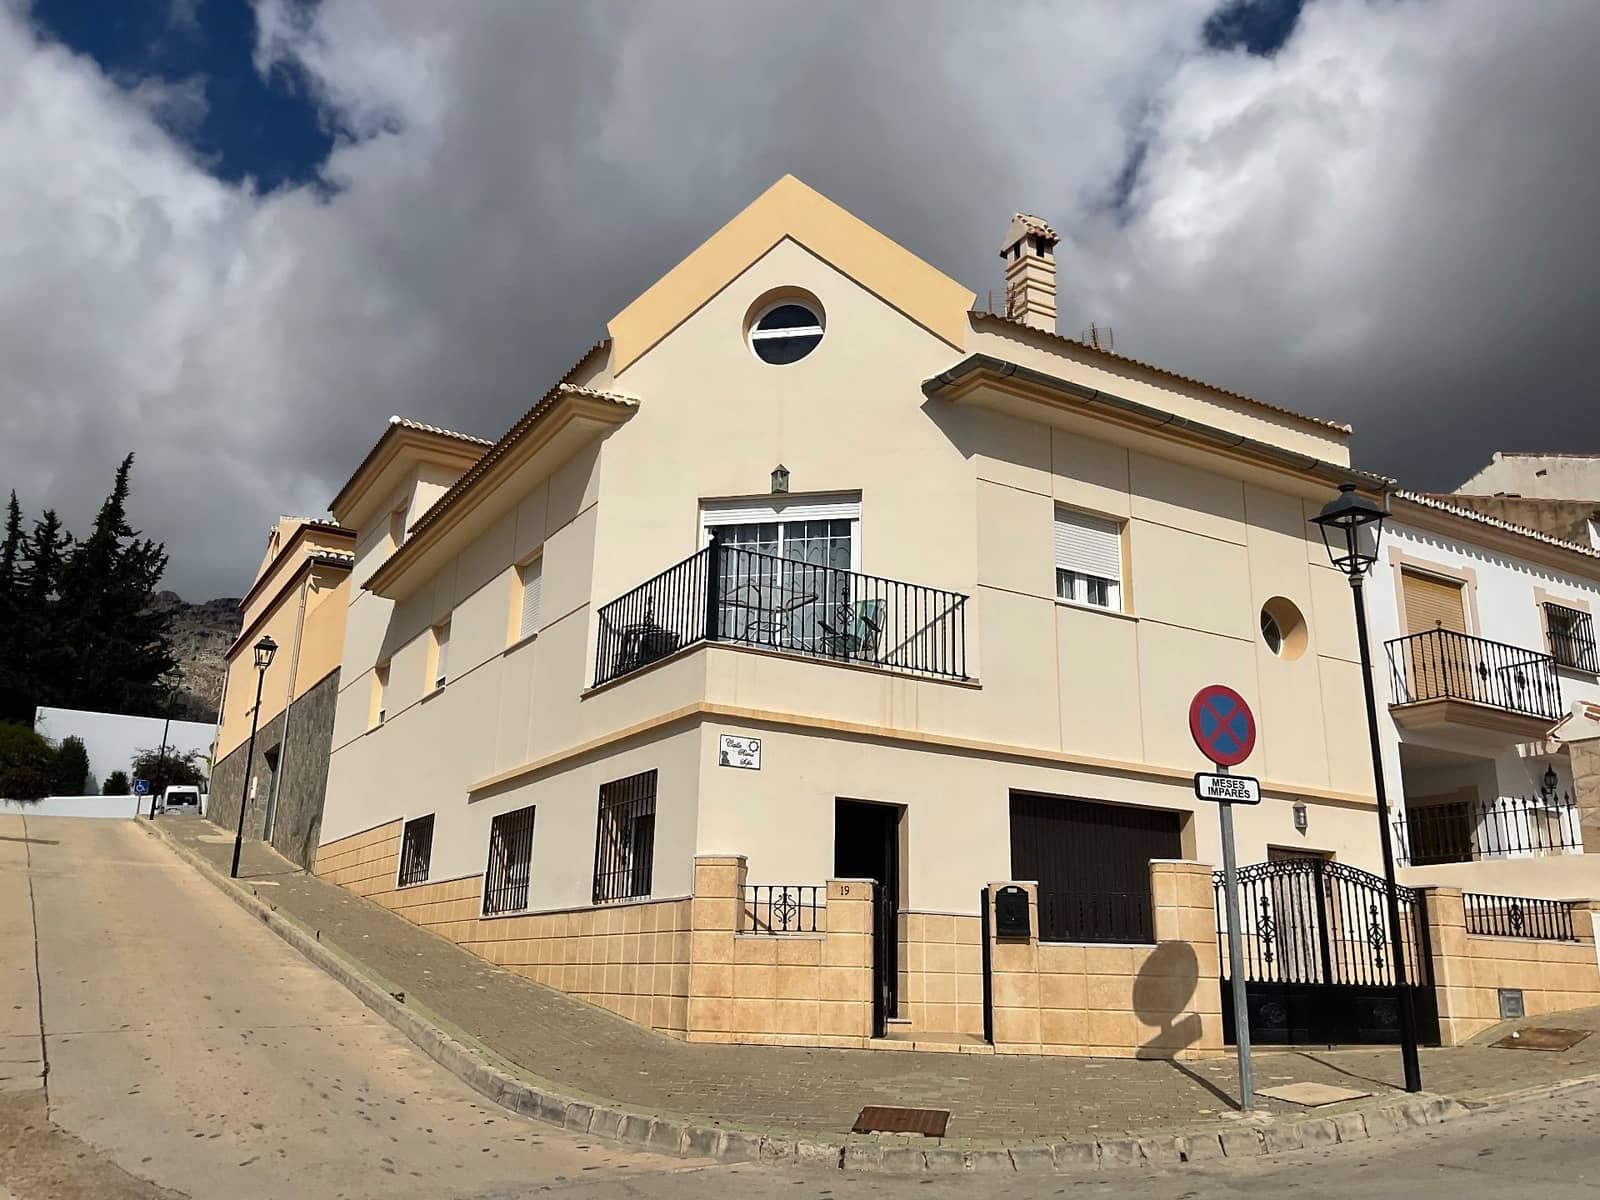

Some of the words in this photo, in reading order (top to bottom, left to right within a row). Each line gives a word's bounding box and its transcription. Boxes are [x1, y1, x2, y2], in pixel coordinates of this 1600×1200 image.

[1212, 778, 1245, 790] MESES
[1207, 786, 1251, 799] IMPARES
[840, 885, 850, 896] 19
